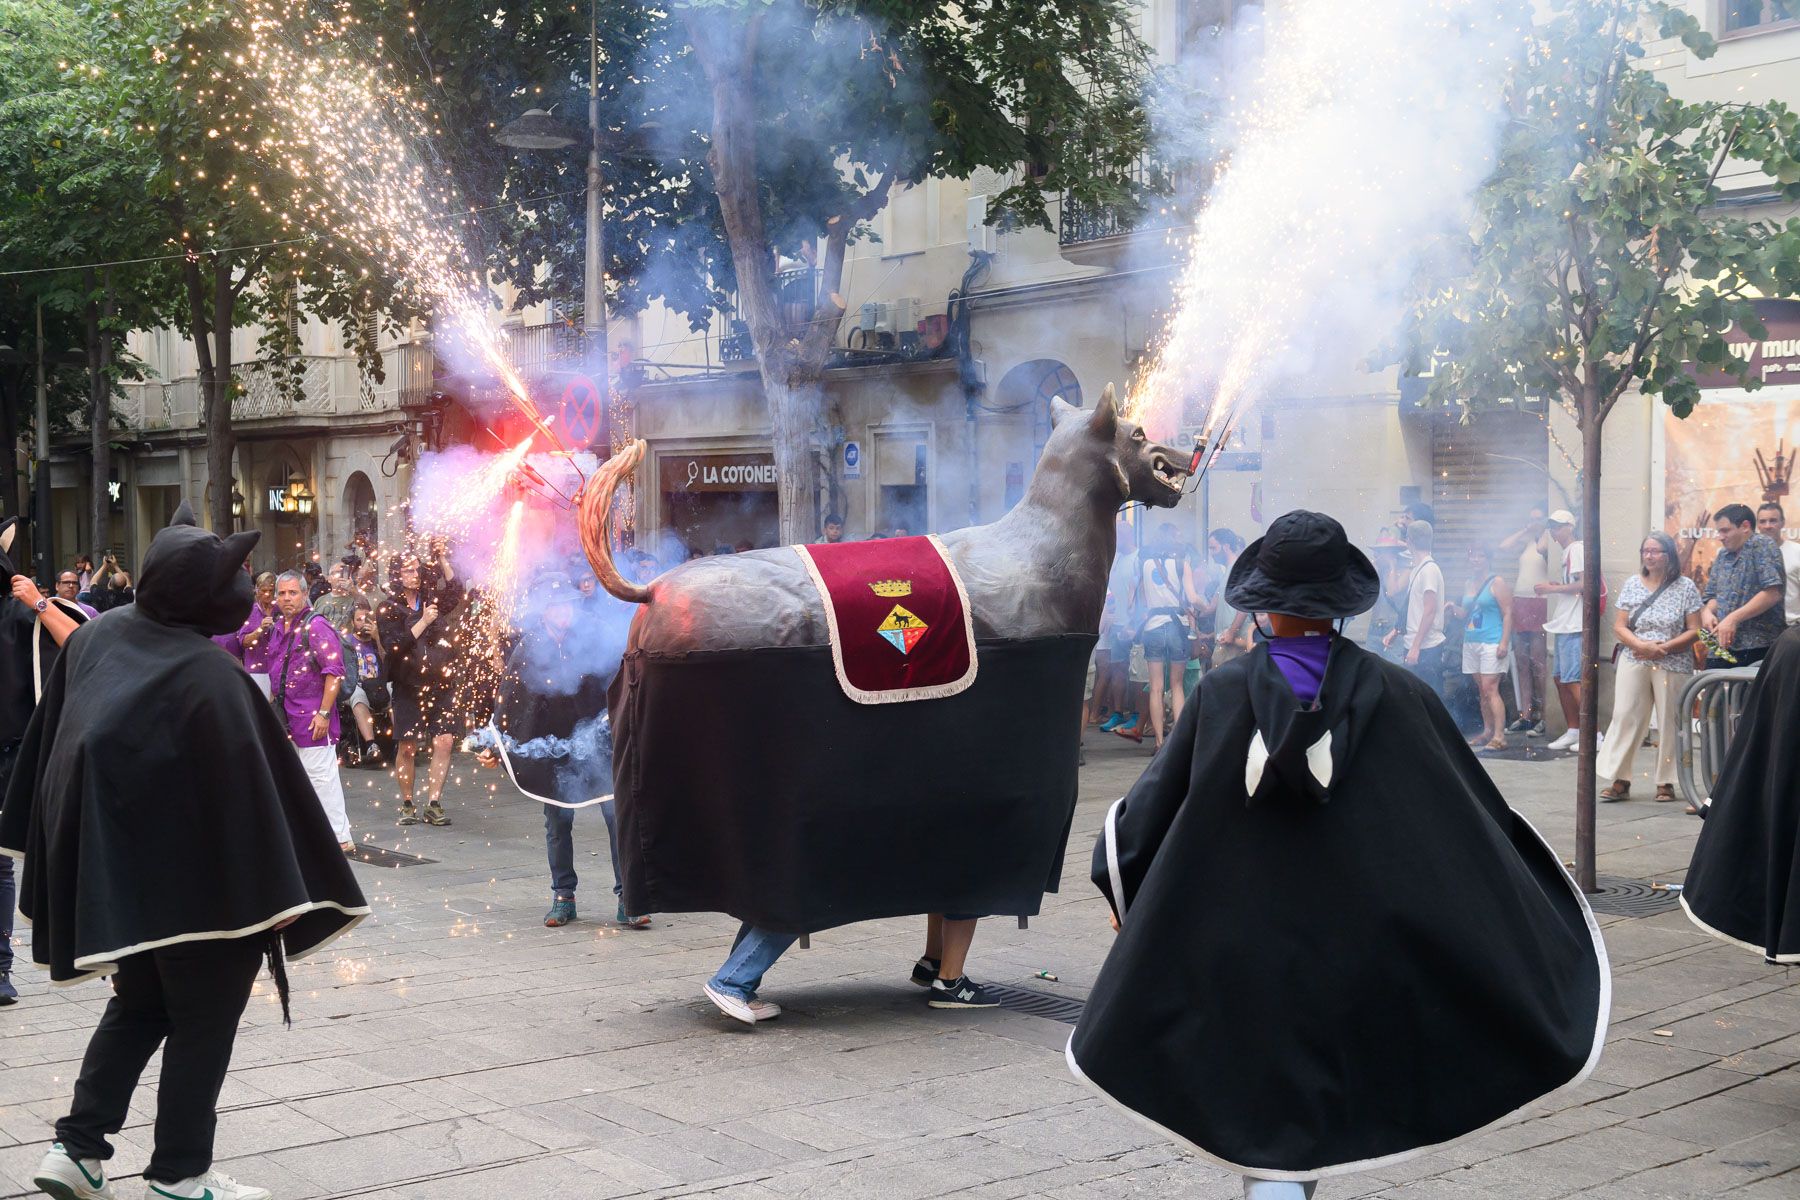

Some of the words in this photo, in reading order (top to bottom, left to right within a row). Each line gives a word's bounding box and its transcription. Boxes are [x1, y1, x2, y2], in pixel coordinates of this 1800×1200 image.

[1728, 341, 1757, 363] uy
[703, 466, 719, 484] LA
[958, 988, 975, 1001] N
